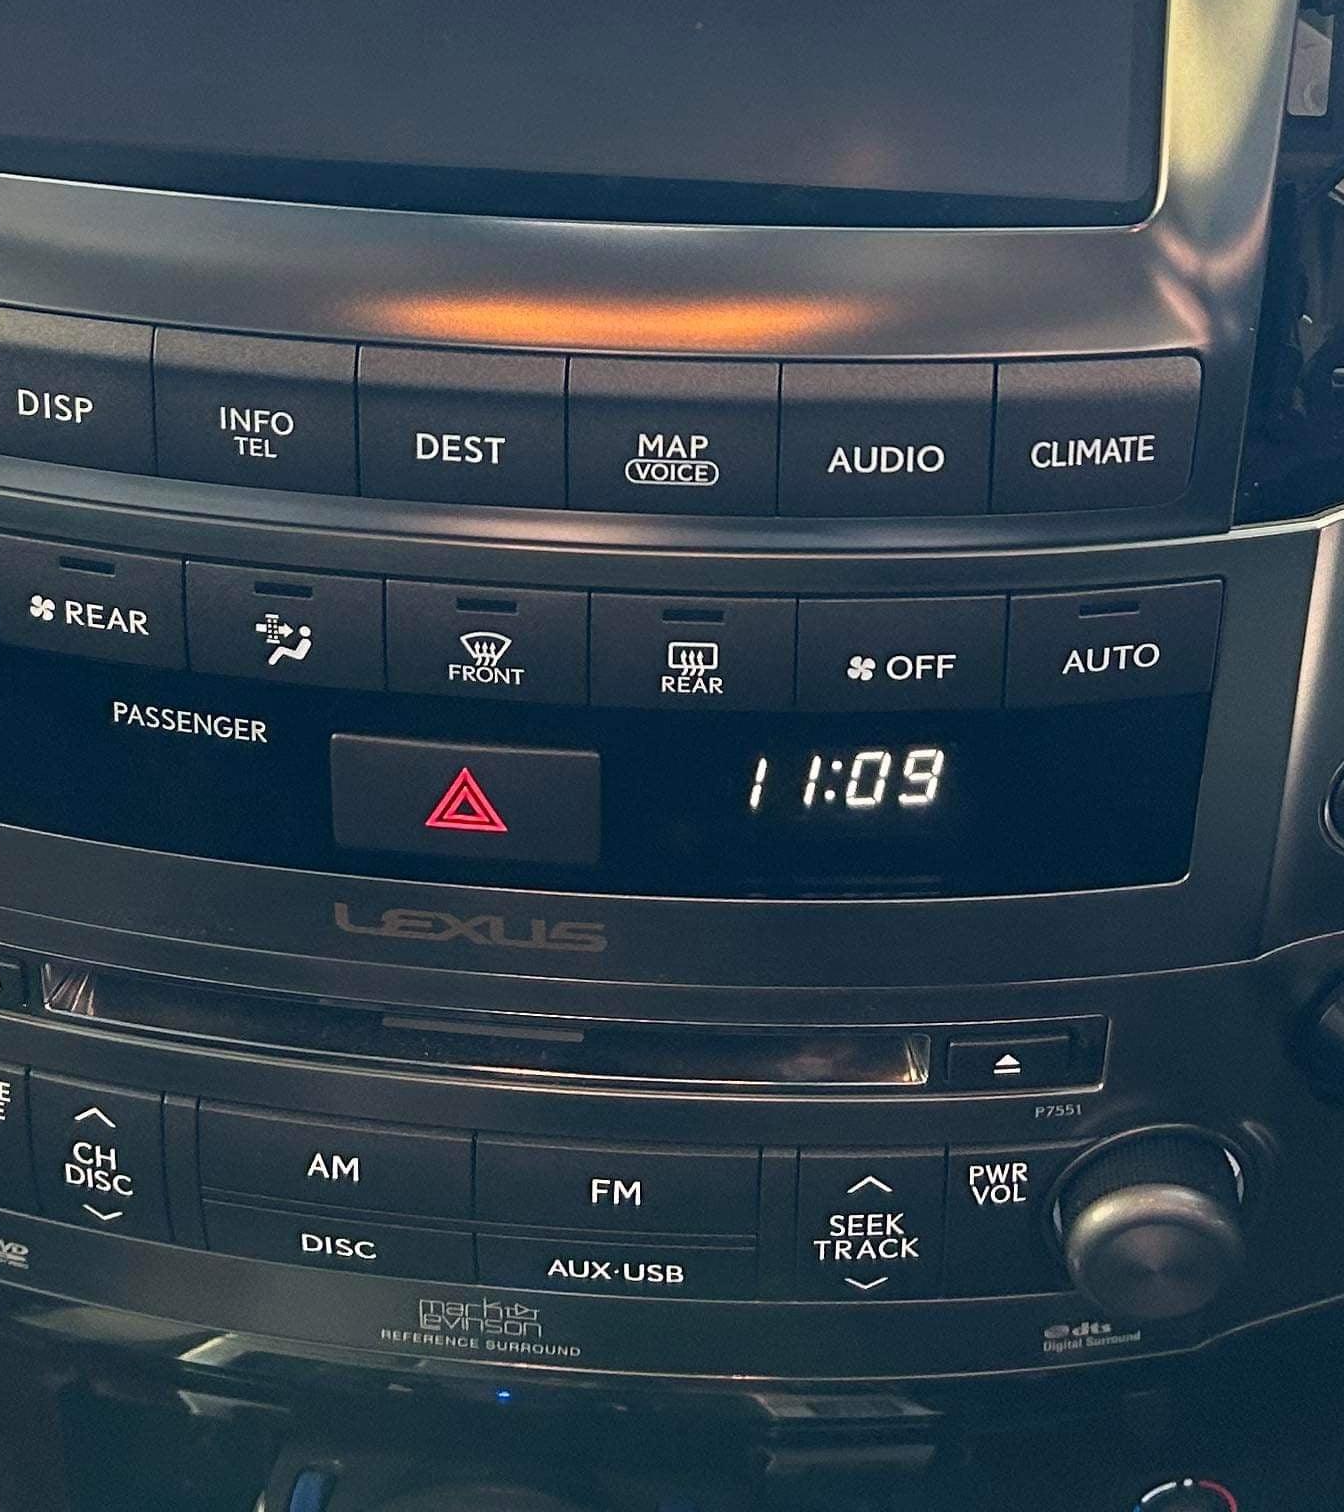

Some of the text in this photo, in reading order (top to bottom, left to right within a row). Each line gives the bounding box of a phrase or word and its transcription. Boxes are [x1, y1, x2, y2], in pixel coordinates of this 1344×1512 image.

[17, 388, 94, 423] DISP
[219, 406, 294, 436] INFO
[233, 437, 277, 458] TEL
[416, 433, 506, 465] DEST
[638, 434, 709, 459] MAP
[828, 446, 945, 474] AUDIO
[1030, 435, 1156, 468] CLIMATE
[634, 463, 710, 483] VOICE
[65, 600, 149, 636] REAR
[886, 654, 957, 681] OFF
[1062, 643, 1160, 676] AUTO
[448, 664, 524, 685] FRONT
[661, 675, 723, 694] REAR
[112, 702, 268, 744] PASSENGER
[748, 748, 946, 811] 11:09
[334, 903, 607, 952] LEXUS
[1035, 1104, 1082, 1118] P7551
[72, 1142, 117, 1171] CH
[307, 1154, 360, 1182] AM
[64, 1164, 134, 1196] DISC
[968, 1163, 1028, 1185] PWR
[591, 1179, 642, 1206] FM
[971, 1182, 1026, 1205] VOL
[828, 1213, 905, 1237] SEEK
[301, 1233, 377, 1261] DISC
[814, 1237, 919, 1261] TRACK
[381, 1328, 581, 1357] REFERENCE SURROUND
[1043, 1330, 1141, 1353] Digital Surround
